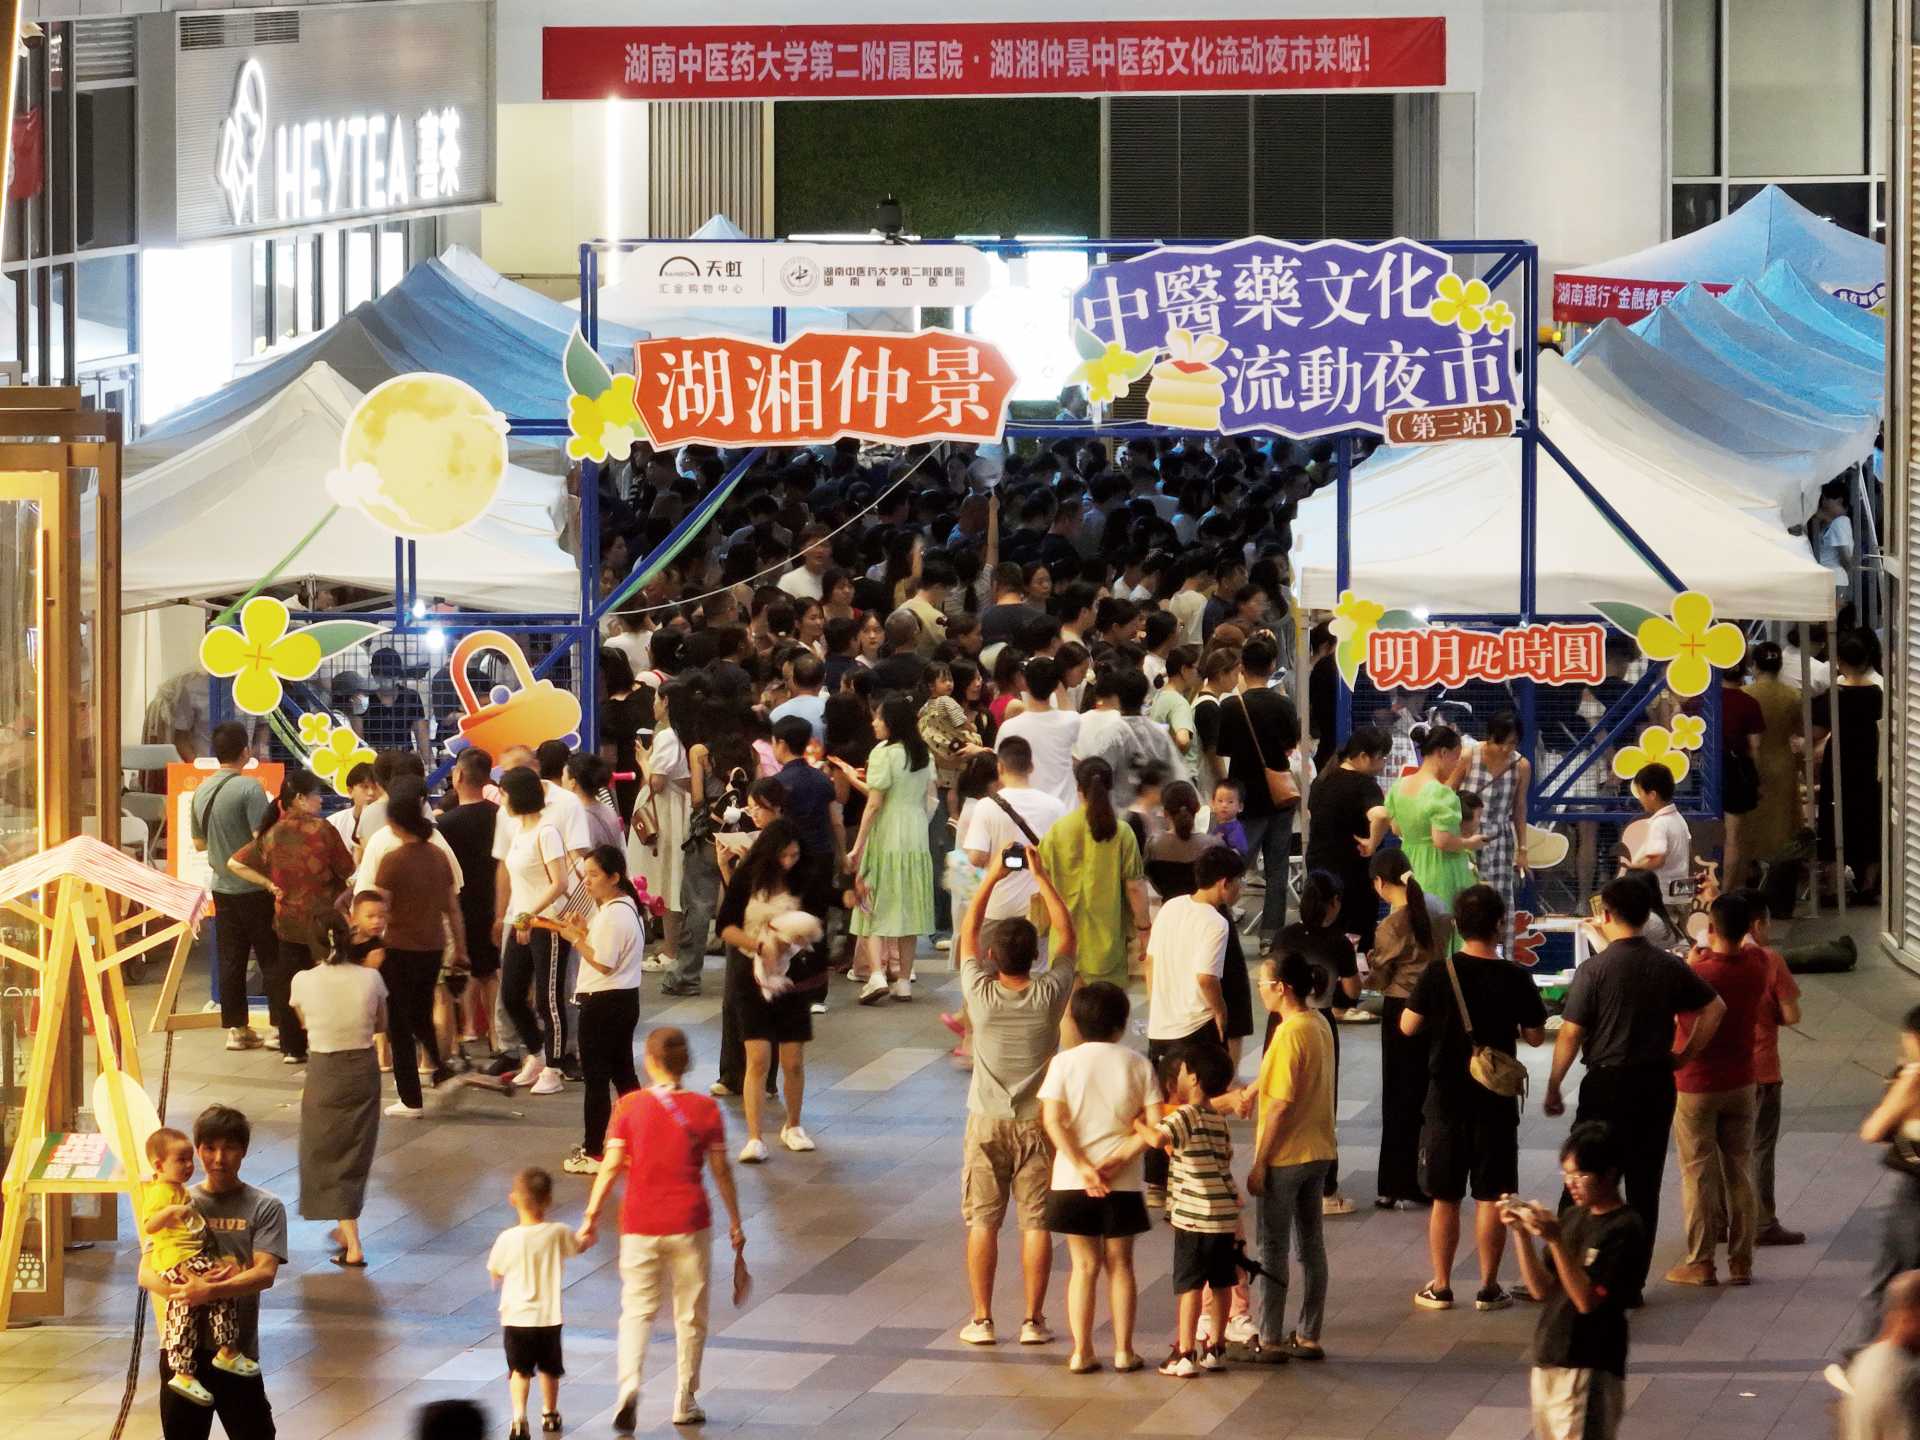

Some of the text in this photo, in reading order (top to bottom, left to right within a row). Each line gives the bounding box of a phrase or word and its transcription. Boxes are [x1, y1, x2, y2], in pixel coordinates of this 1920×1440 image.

[277, 106, 462, 221] HEYTEA 喜茶
[659, 283, 744, 295] 汇金购物中心
[706, 259, 743, 277] 天虹
[823, 266, 966, 277] 湖南中医药大学第二附属医院
[1082, 251, 1434, 347] 中醫藥文化
[656, 345, 996, 434] 湖湘仲景
[1224, 333, 1504, 416] 流動夜市
[1395, 407, 1503, 441] （第三站）
[1373, 631, 1598, 683] 明月此時圓
